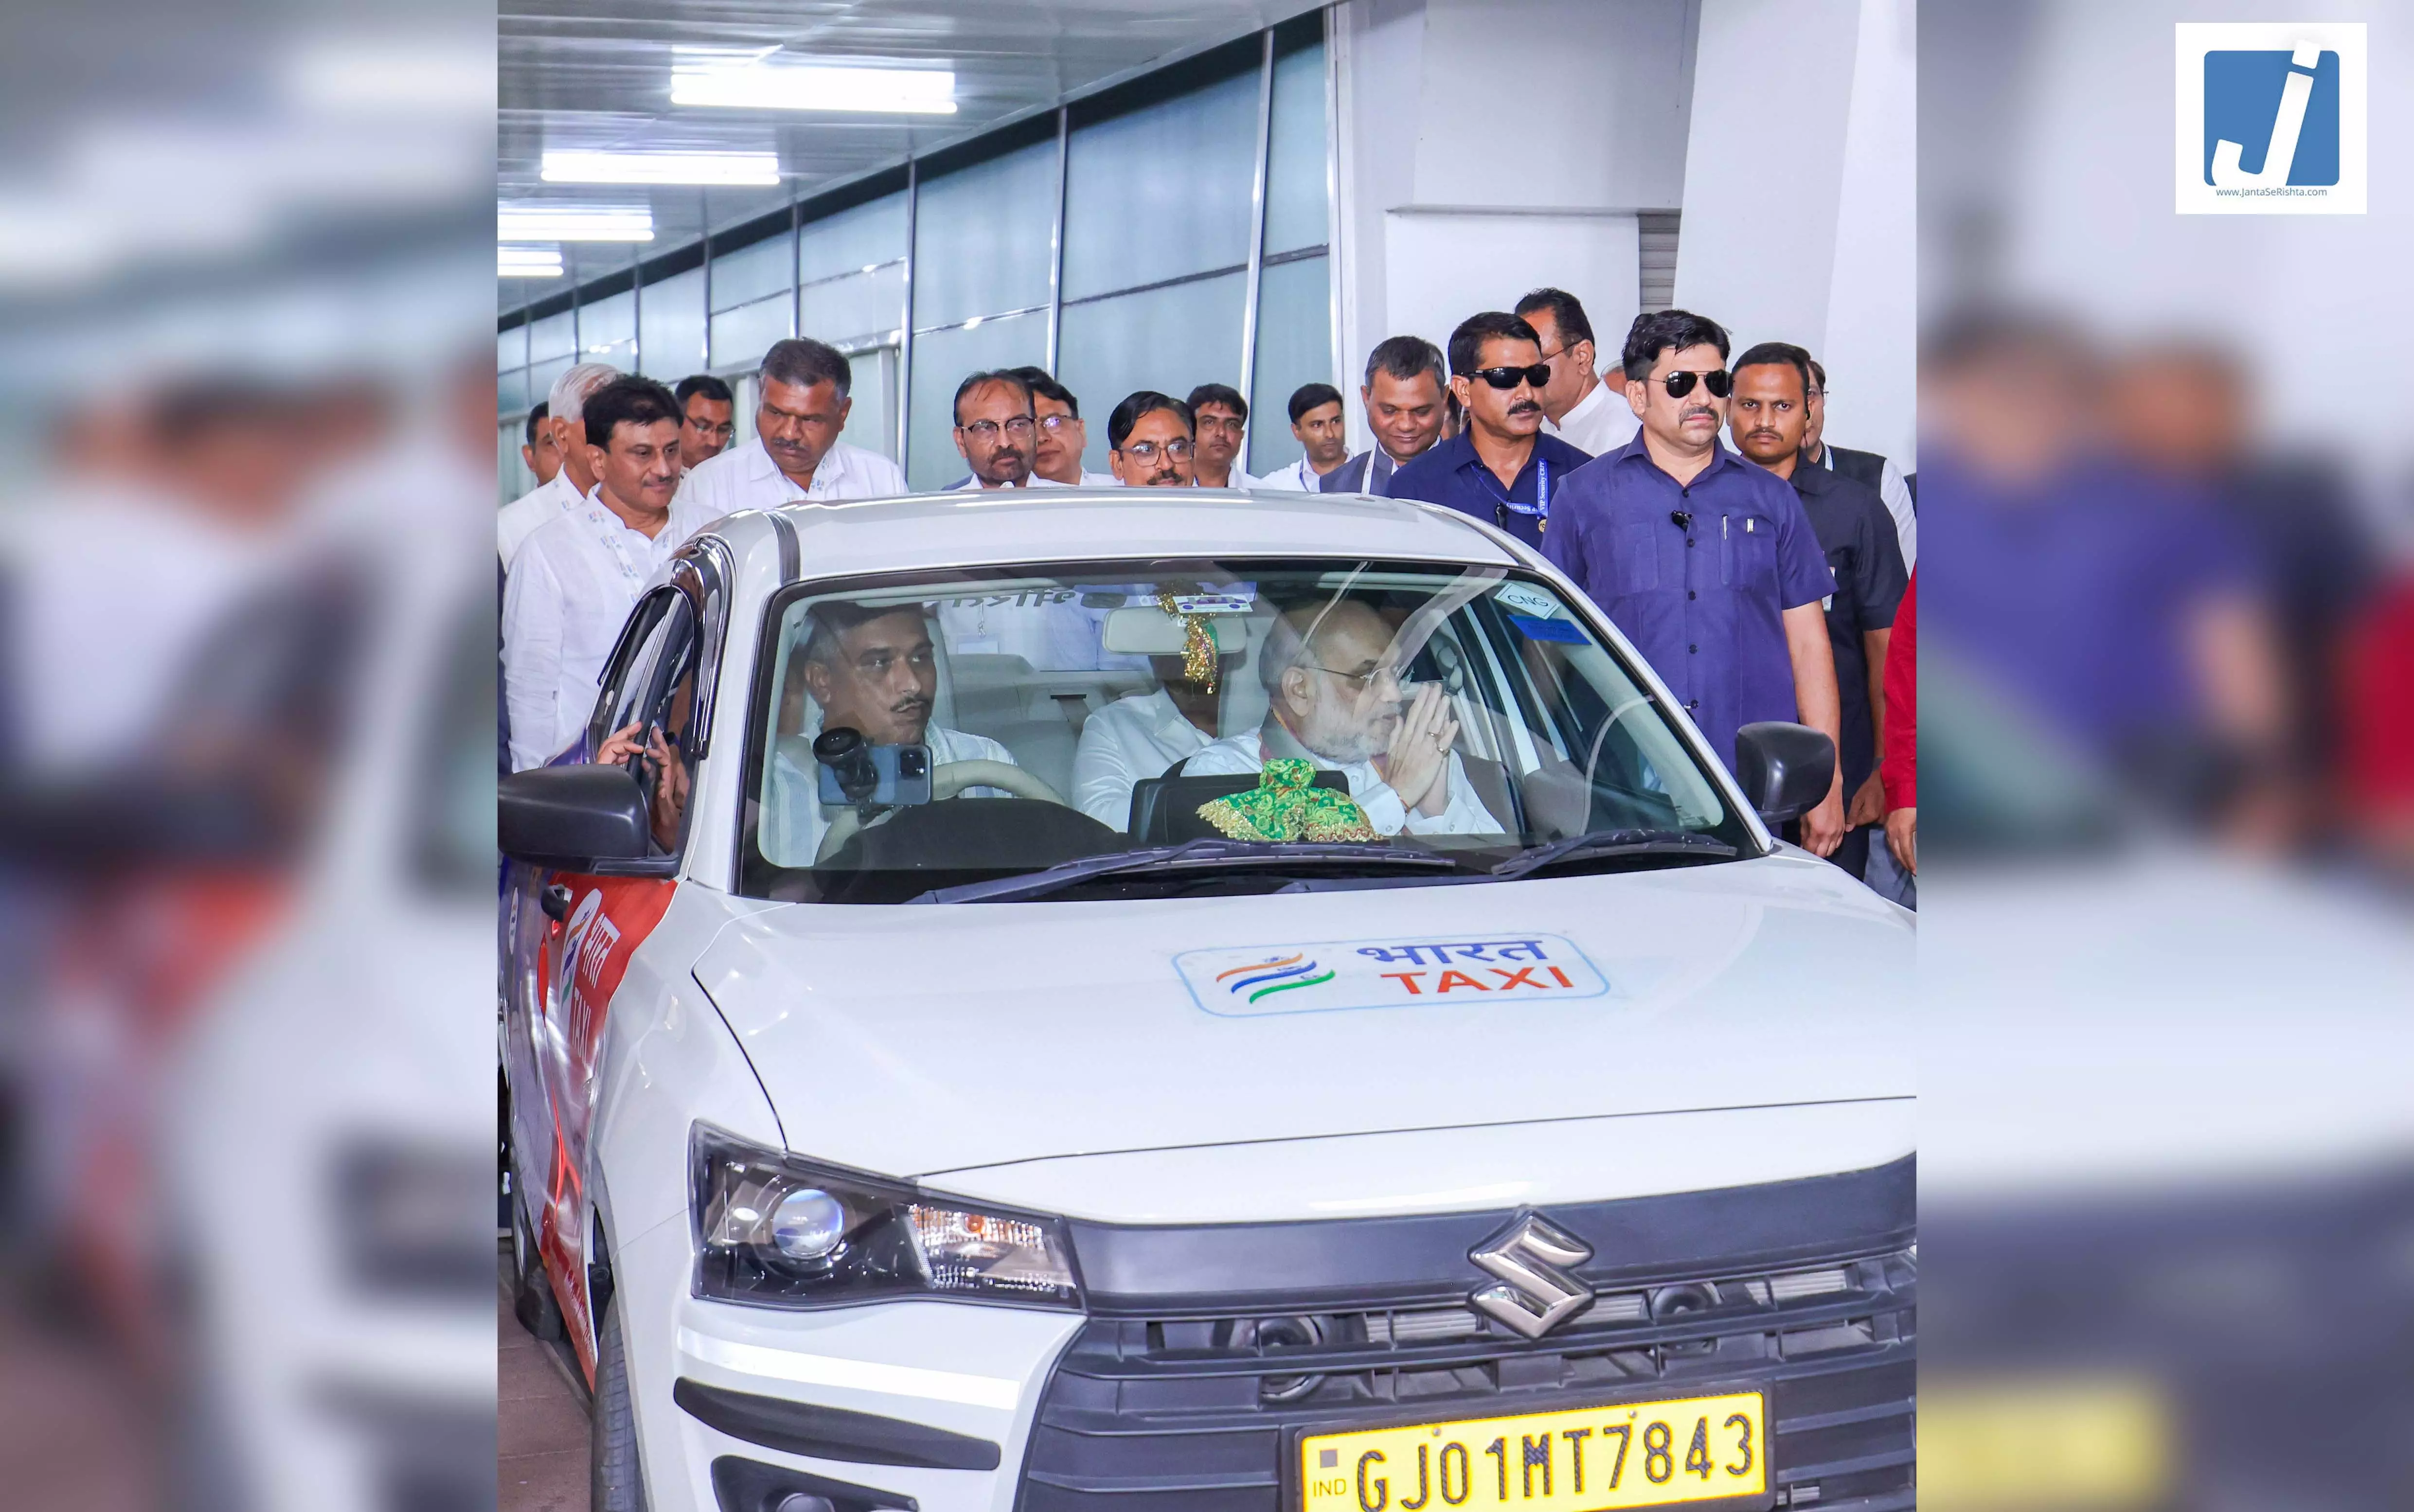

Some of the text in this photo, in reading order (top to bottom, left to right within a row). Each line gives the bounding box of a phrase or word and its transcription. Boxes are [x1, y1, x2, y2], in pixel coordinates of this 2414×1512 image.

[1507, 594, 1549, 606] CNG
[1356, 940, 1549, 965] भारत
[1380, 966, 1574, 994] TAXI
[572, 986, 591, 1064] TAXI
[1357, 1413, 1753, 1512] GJ01MT7843
[1313, 1480, 1346, 1498] IND
